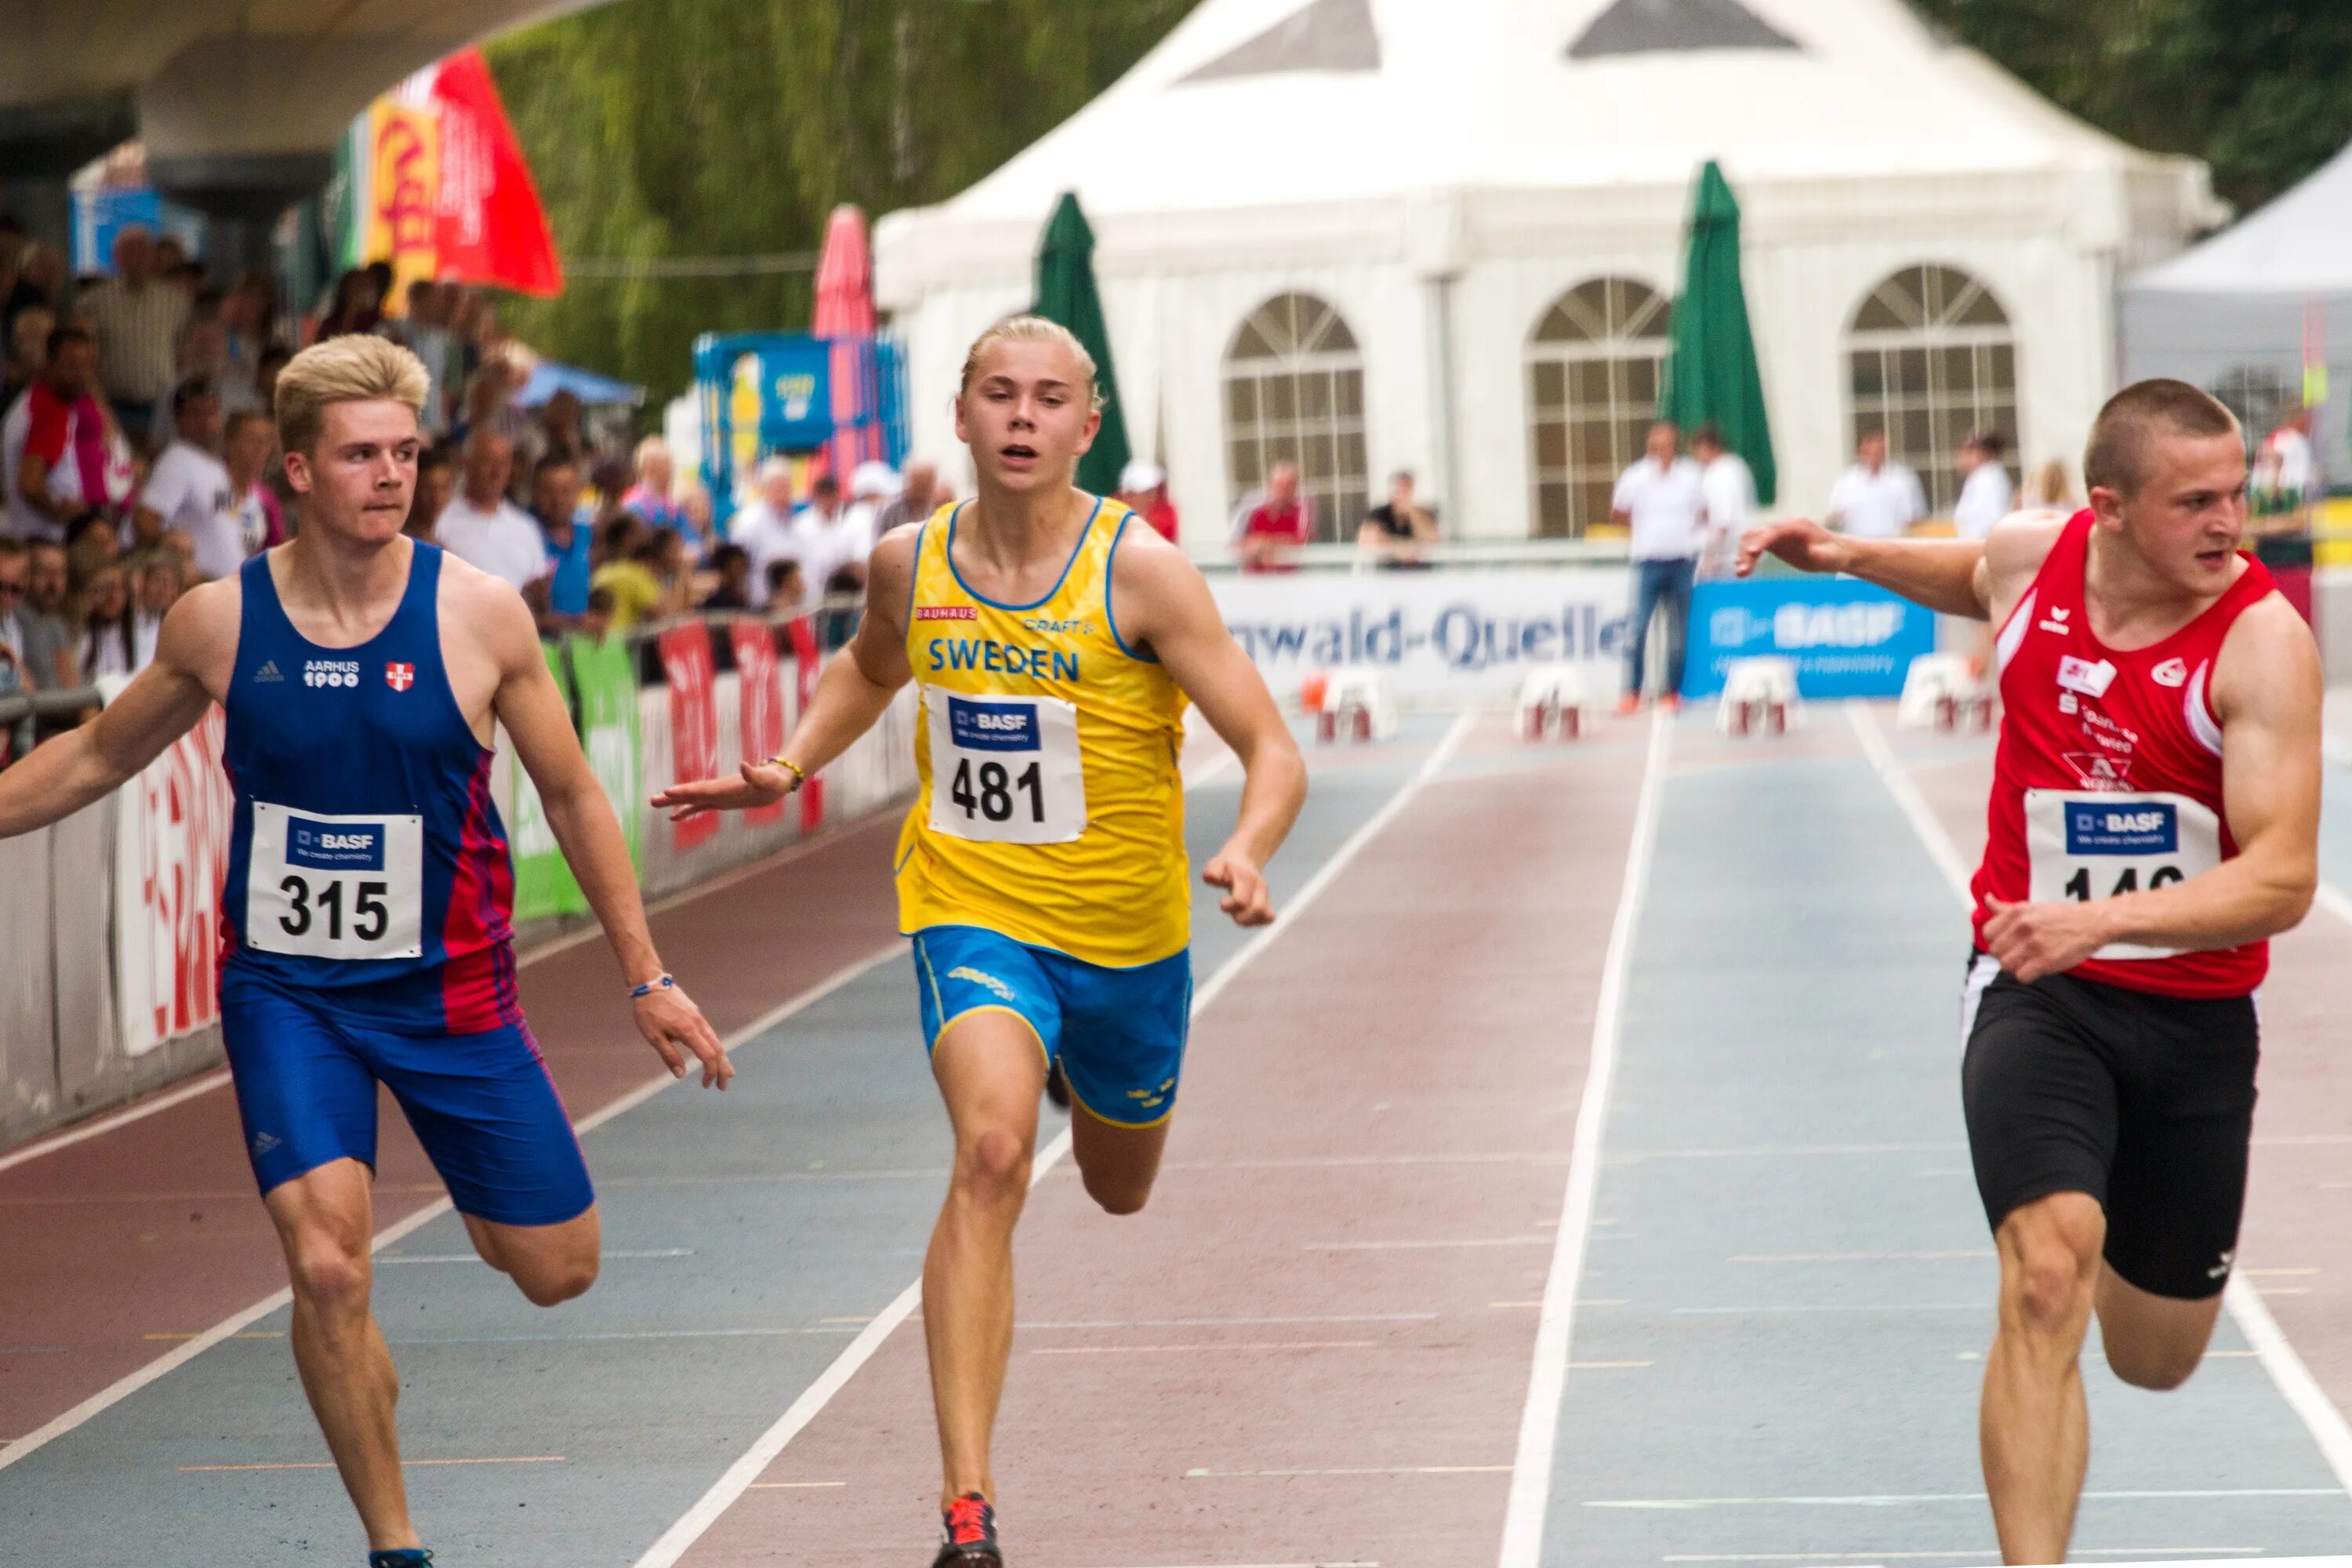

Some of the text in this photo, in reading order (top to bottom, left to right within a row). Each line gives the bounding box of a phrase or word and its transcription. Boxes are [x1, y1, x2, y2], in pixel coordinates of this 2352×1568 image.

[916, 608, 977, 620] BAUHAUS
[1022, 619, 1080, 634] CRAFT
[1773, 601, 1906, 649] BASF
[306, 660, 360, 673] AARHUS
[929, 638, 1080, 682] SWEDEN
[303, 672, 360, 688] 1900
[977, 713, 1027, 731] BASF
[952, 757, 1045, 822] 481
[2106, 811, 2165, 833] BASF
[320, 833, 374, 850] BASF
[309, 851, 333, 861] create
[334, 853, 374, 862] chemistry
[279, 875, 389, 941] 315
